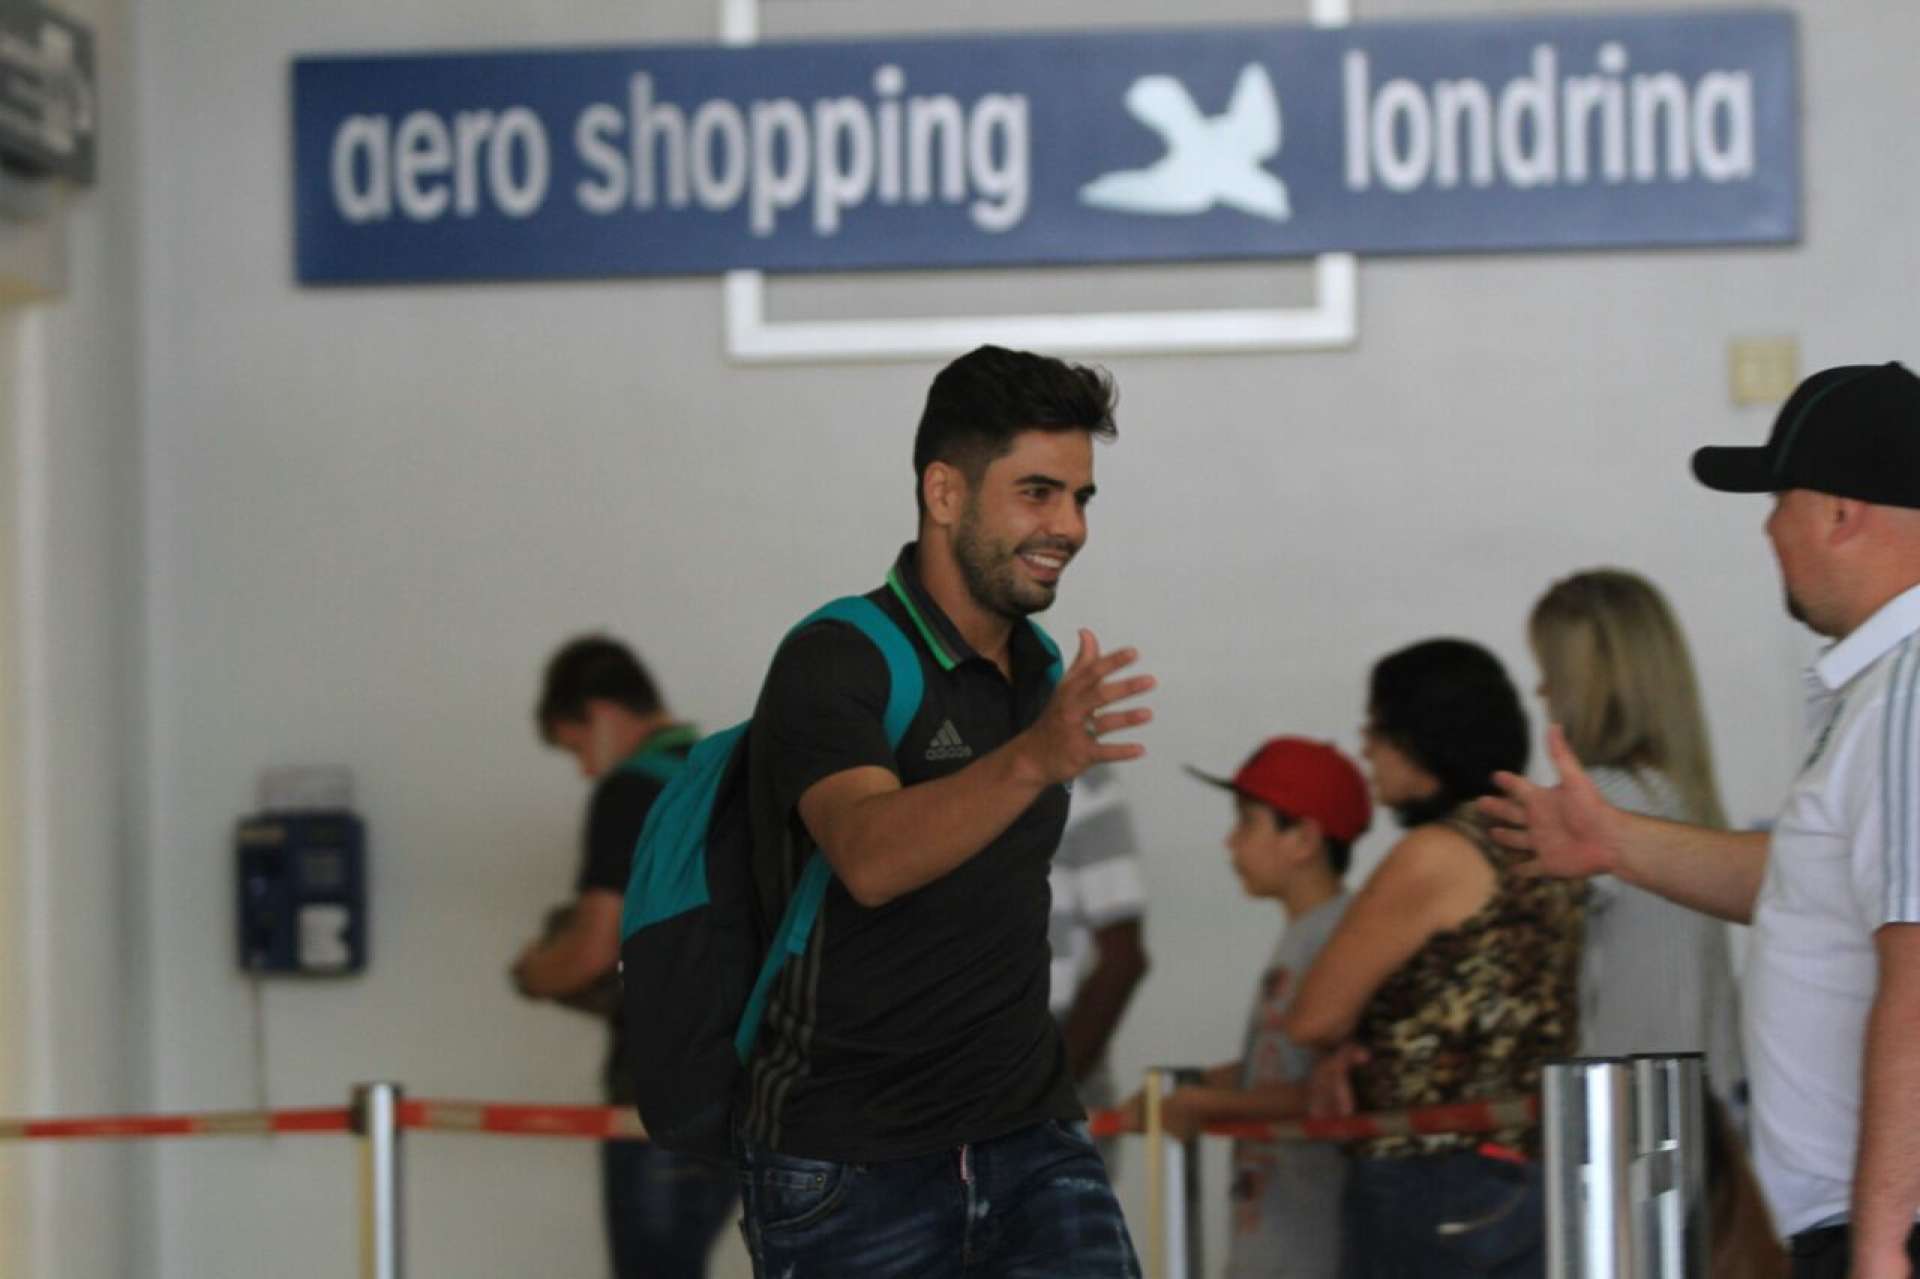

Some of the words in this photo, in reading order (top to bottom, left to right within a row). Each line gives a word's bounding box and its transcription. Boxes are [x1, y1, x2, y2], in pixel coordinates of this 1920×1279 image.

[331, 107, 549, 223] aero
[574, 65, 1030, 236] shopping
[1343, 43, 1754, 192] londrina
